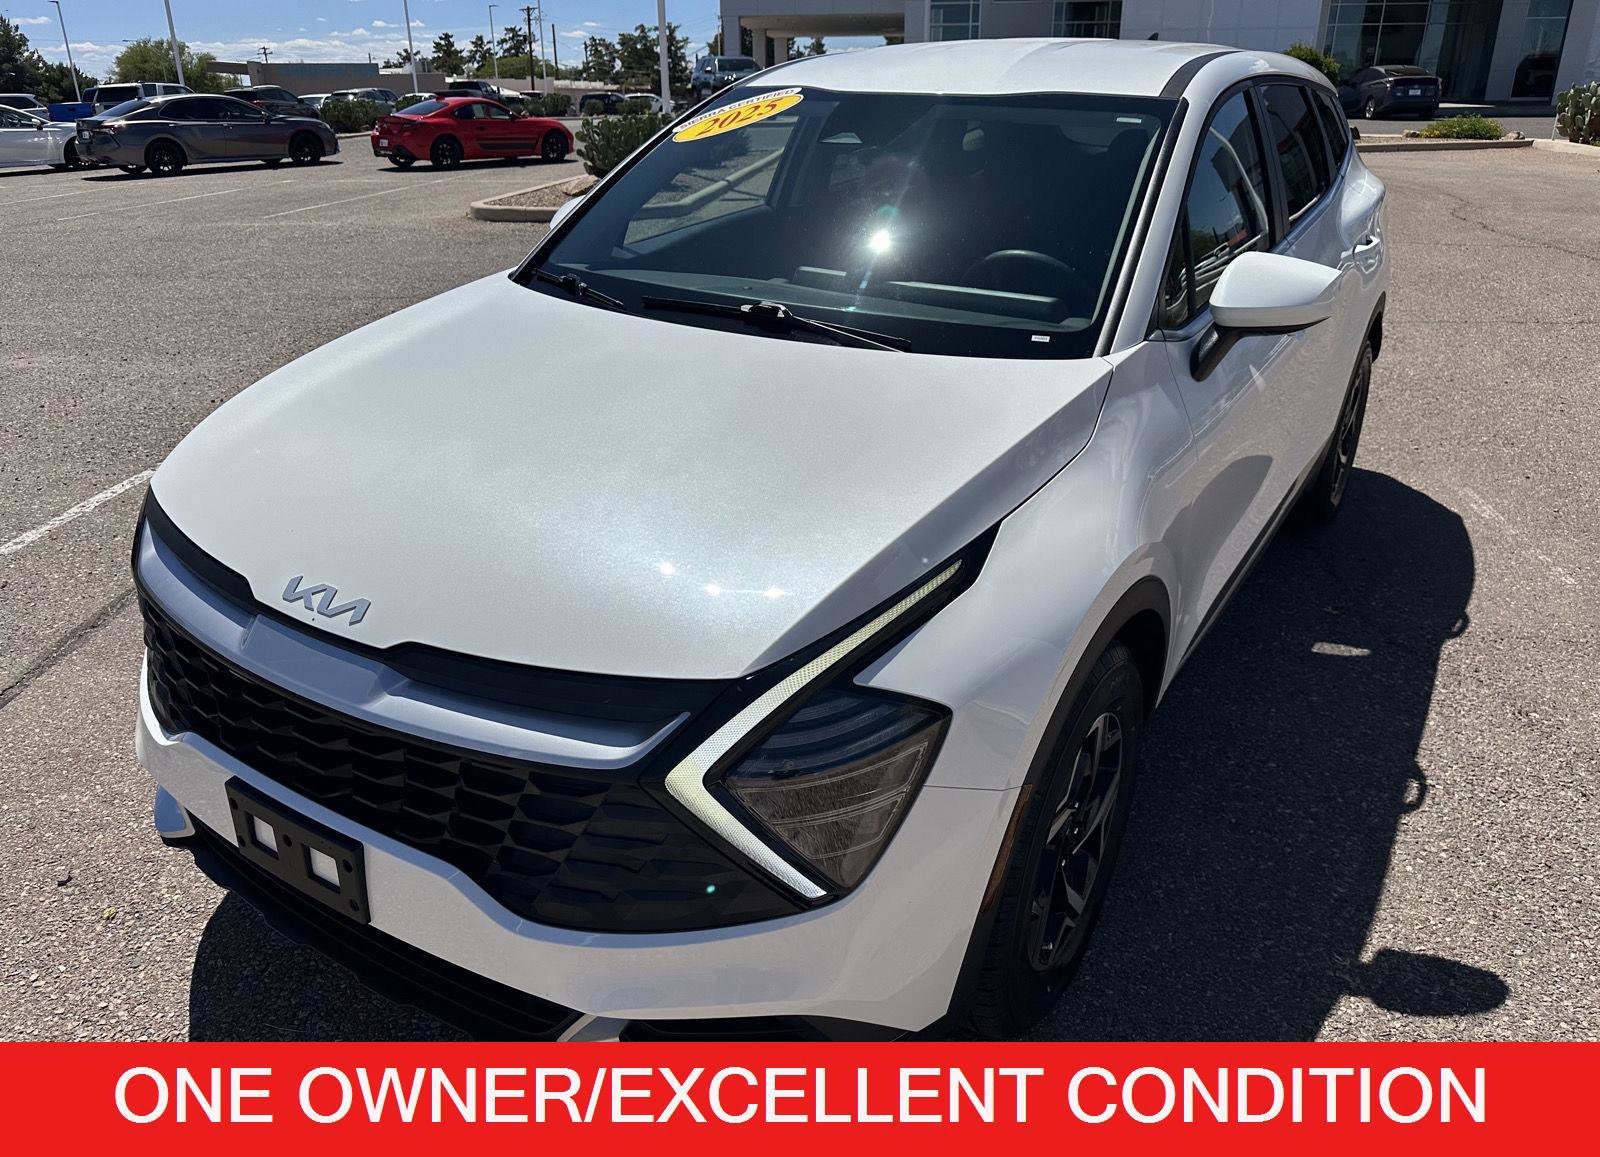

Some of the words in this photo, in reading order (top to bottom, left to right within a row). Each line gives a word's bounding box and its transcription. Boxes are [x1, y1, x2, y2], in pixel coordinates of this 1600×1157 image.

[695, 98, 784, 137] 2025
[729, 89, 795, 110] CERTIFIED
[282, 575, 371, 626] KIA
